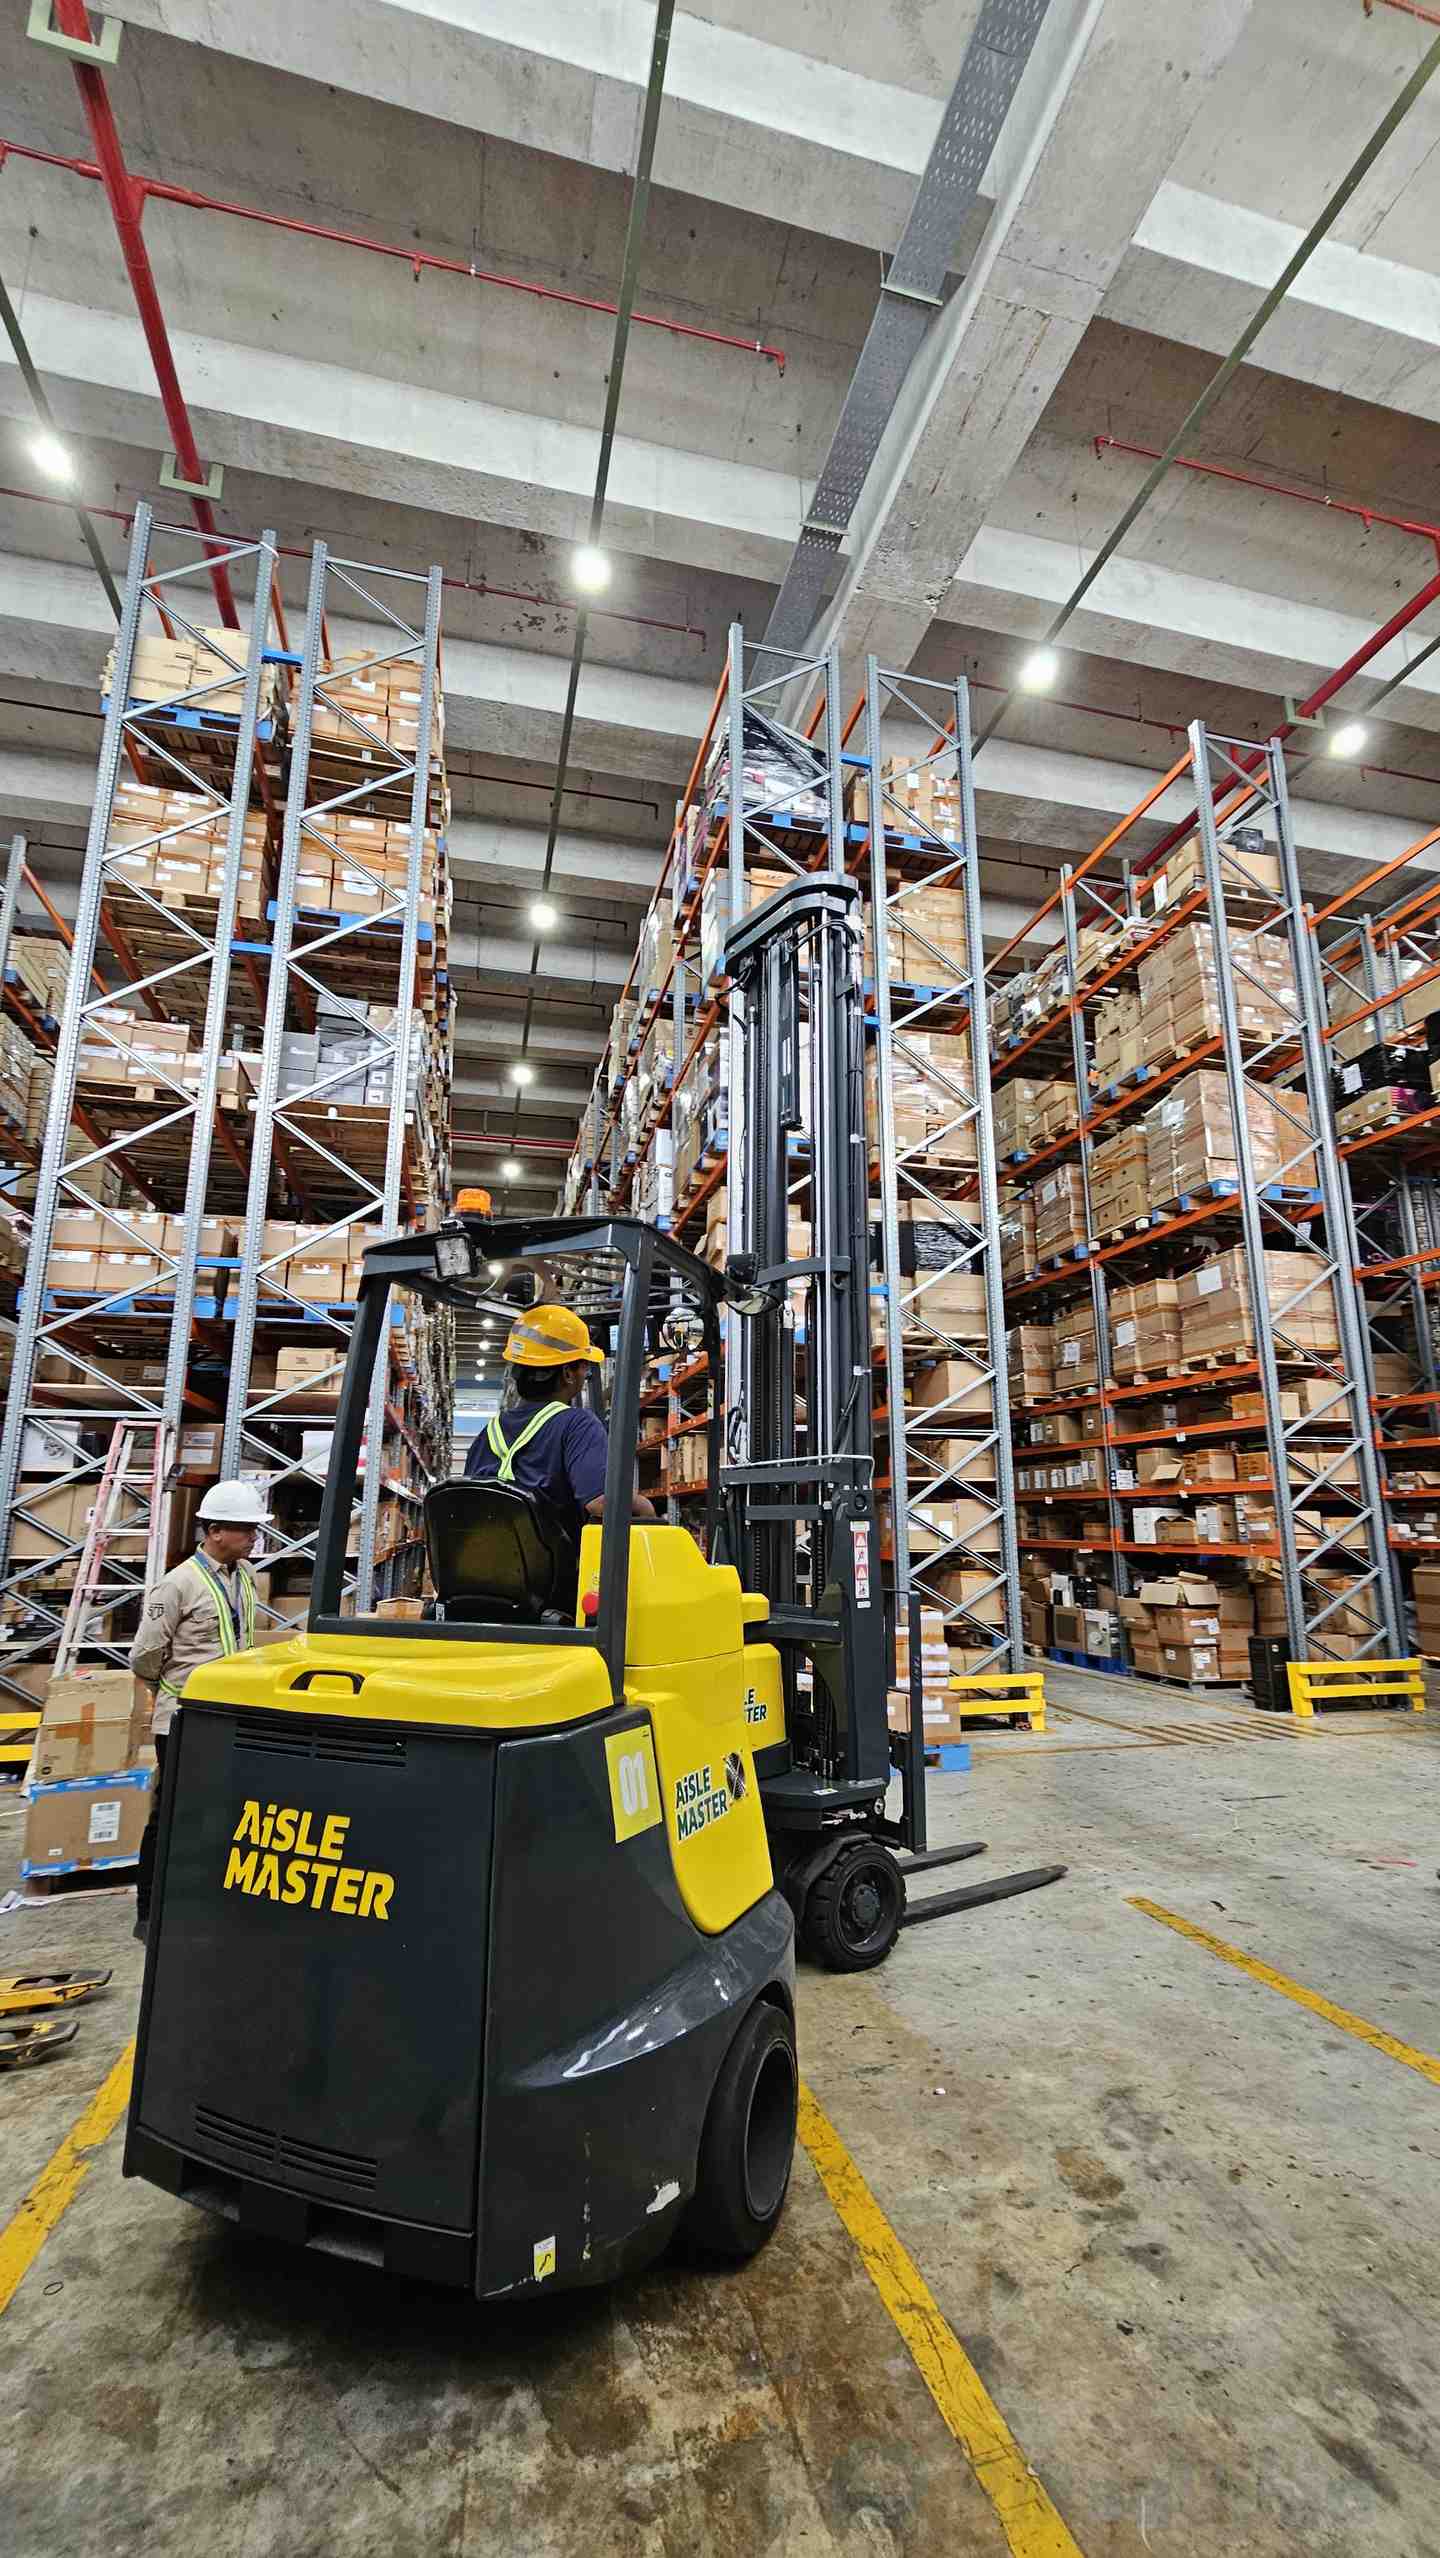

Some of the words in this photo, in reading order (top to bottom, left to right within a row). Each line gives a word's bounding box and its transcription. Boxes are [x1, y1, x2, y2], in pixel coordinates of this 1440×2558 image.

[744, 1704, 767, 1724] TER
[619, 1751, 649, 1817] 01
[677, 1789, 729, 1841] MASTER
[223, 1847, 395, 1920] MASTER
